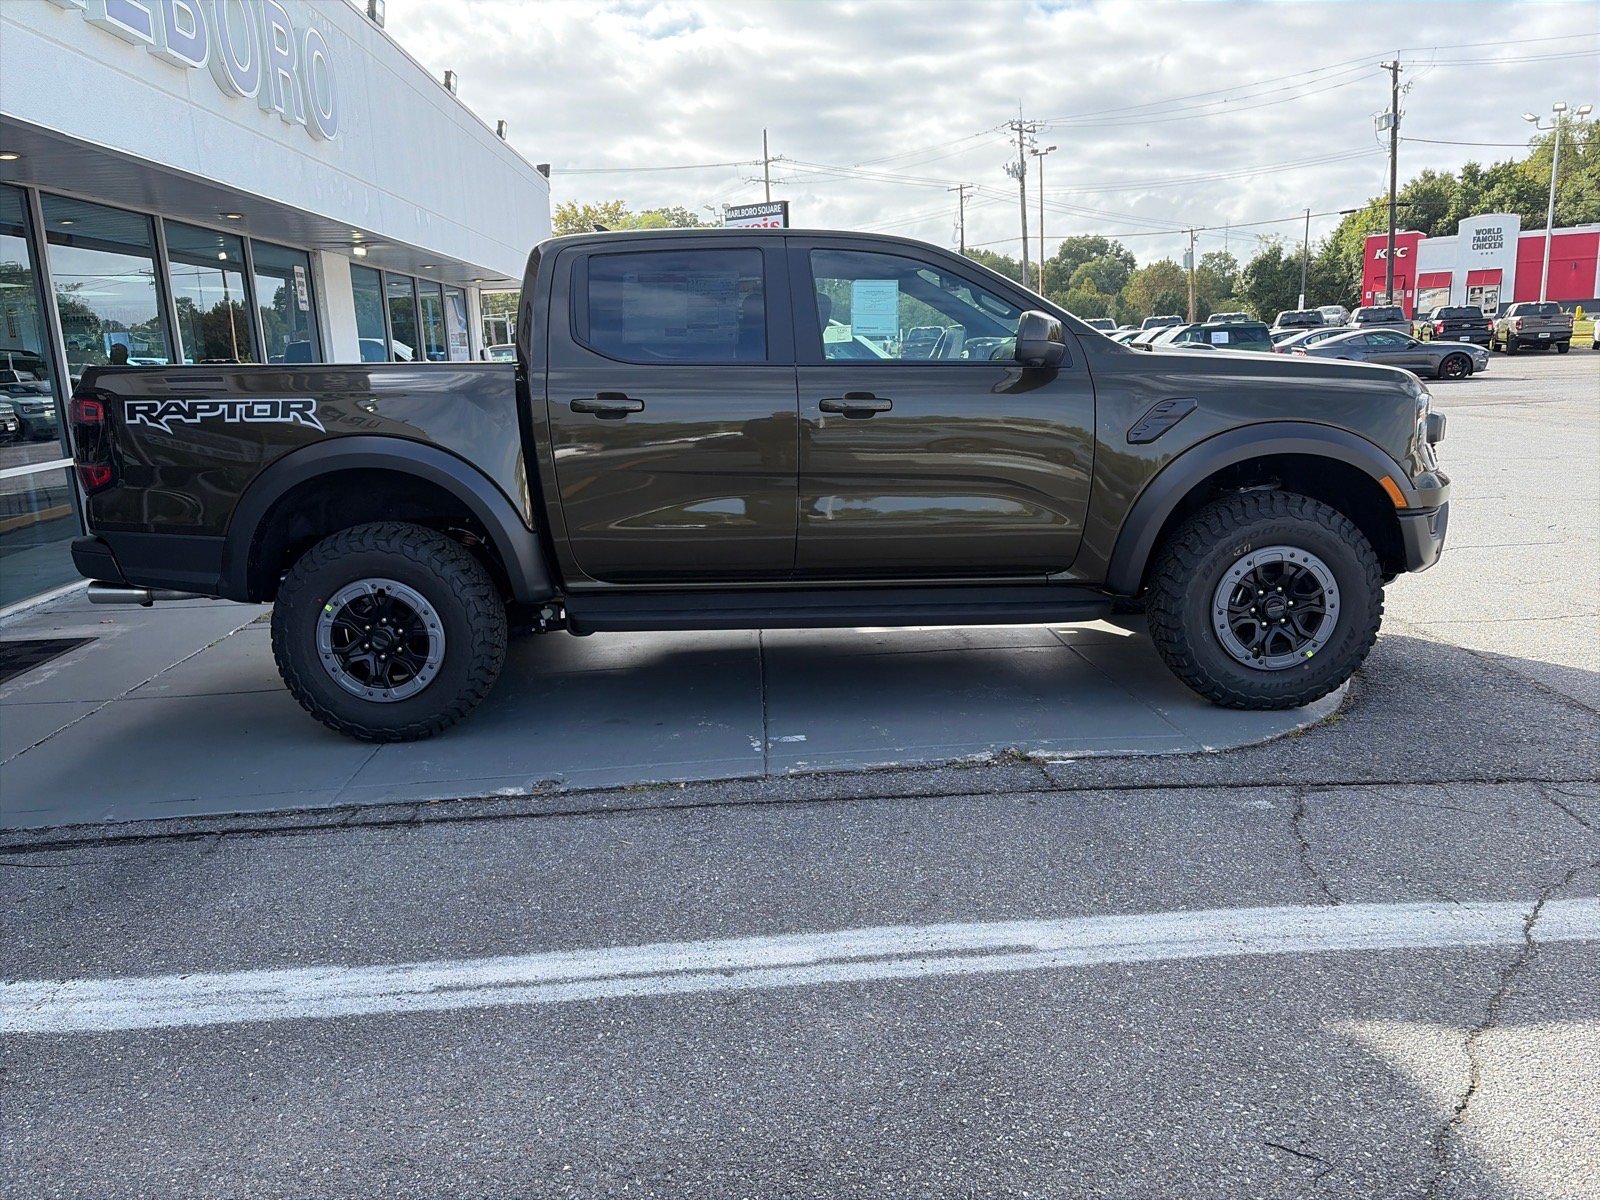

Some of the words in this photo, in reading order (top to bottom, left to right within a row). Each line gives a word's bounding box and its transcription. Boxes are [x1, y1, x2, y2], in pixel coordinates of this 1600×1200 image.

[76, 0, 341, 142] BORO
[727, 207, 757, 218] MARLBORO
[757, 204, 782, 214] SQUARE
[1475, 227, 1502, 236] WORLD
[1472, 234, 1503, 243] FAMOUS
[1472, 242, 1503, 251] CHICKEN
[124, 398, 327, 435] RAPTOR
